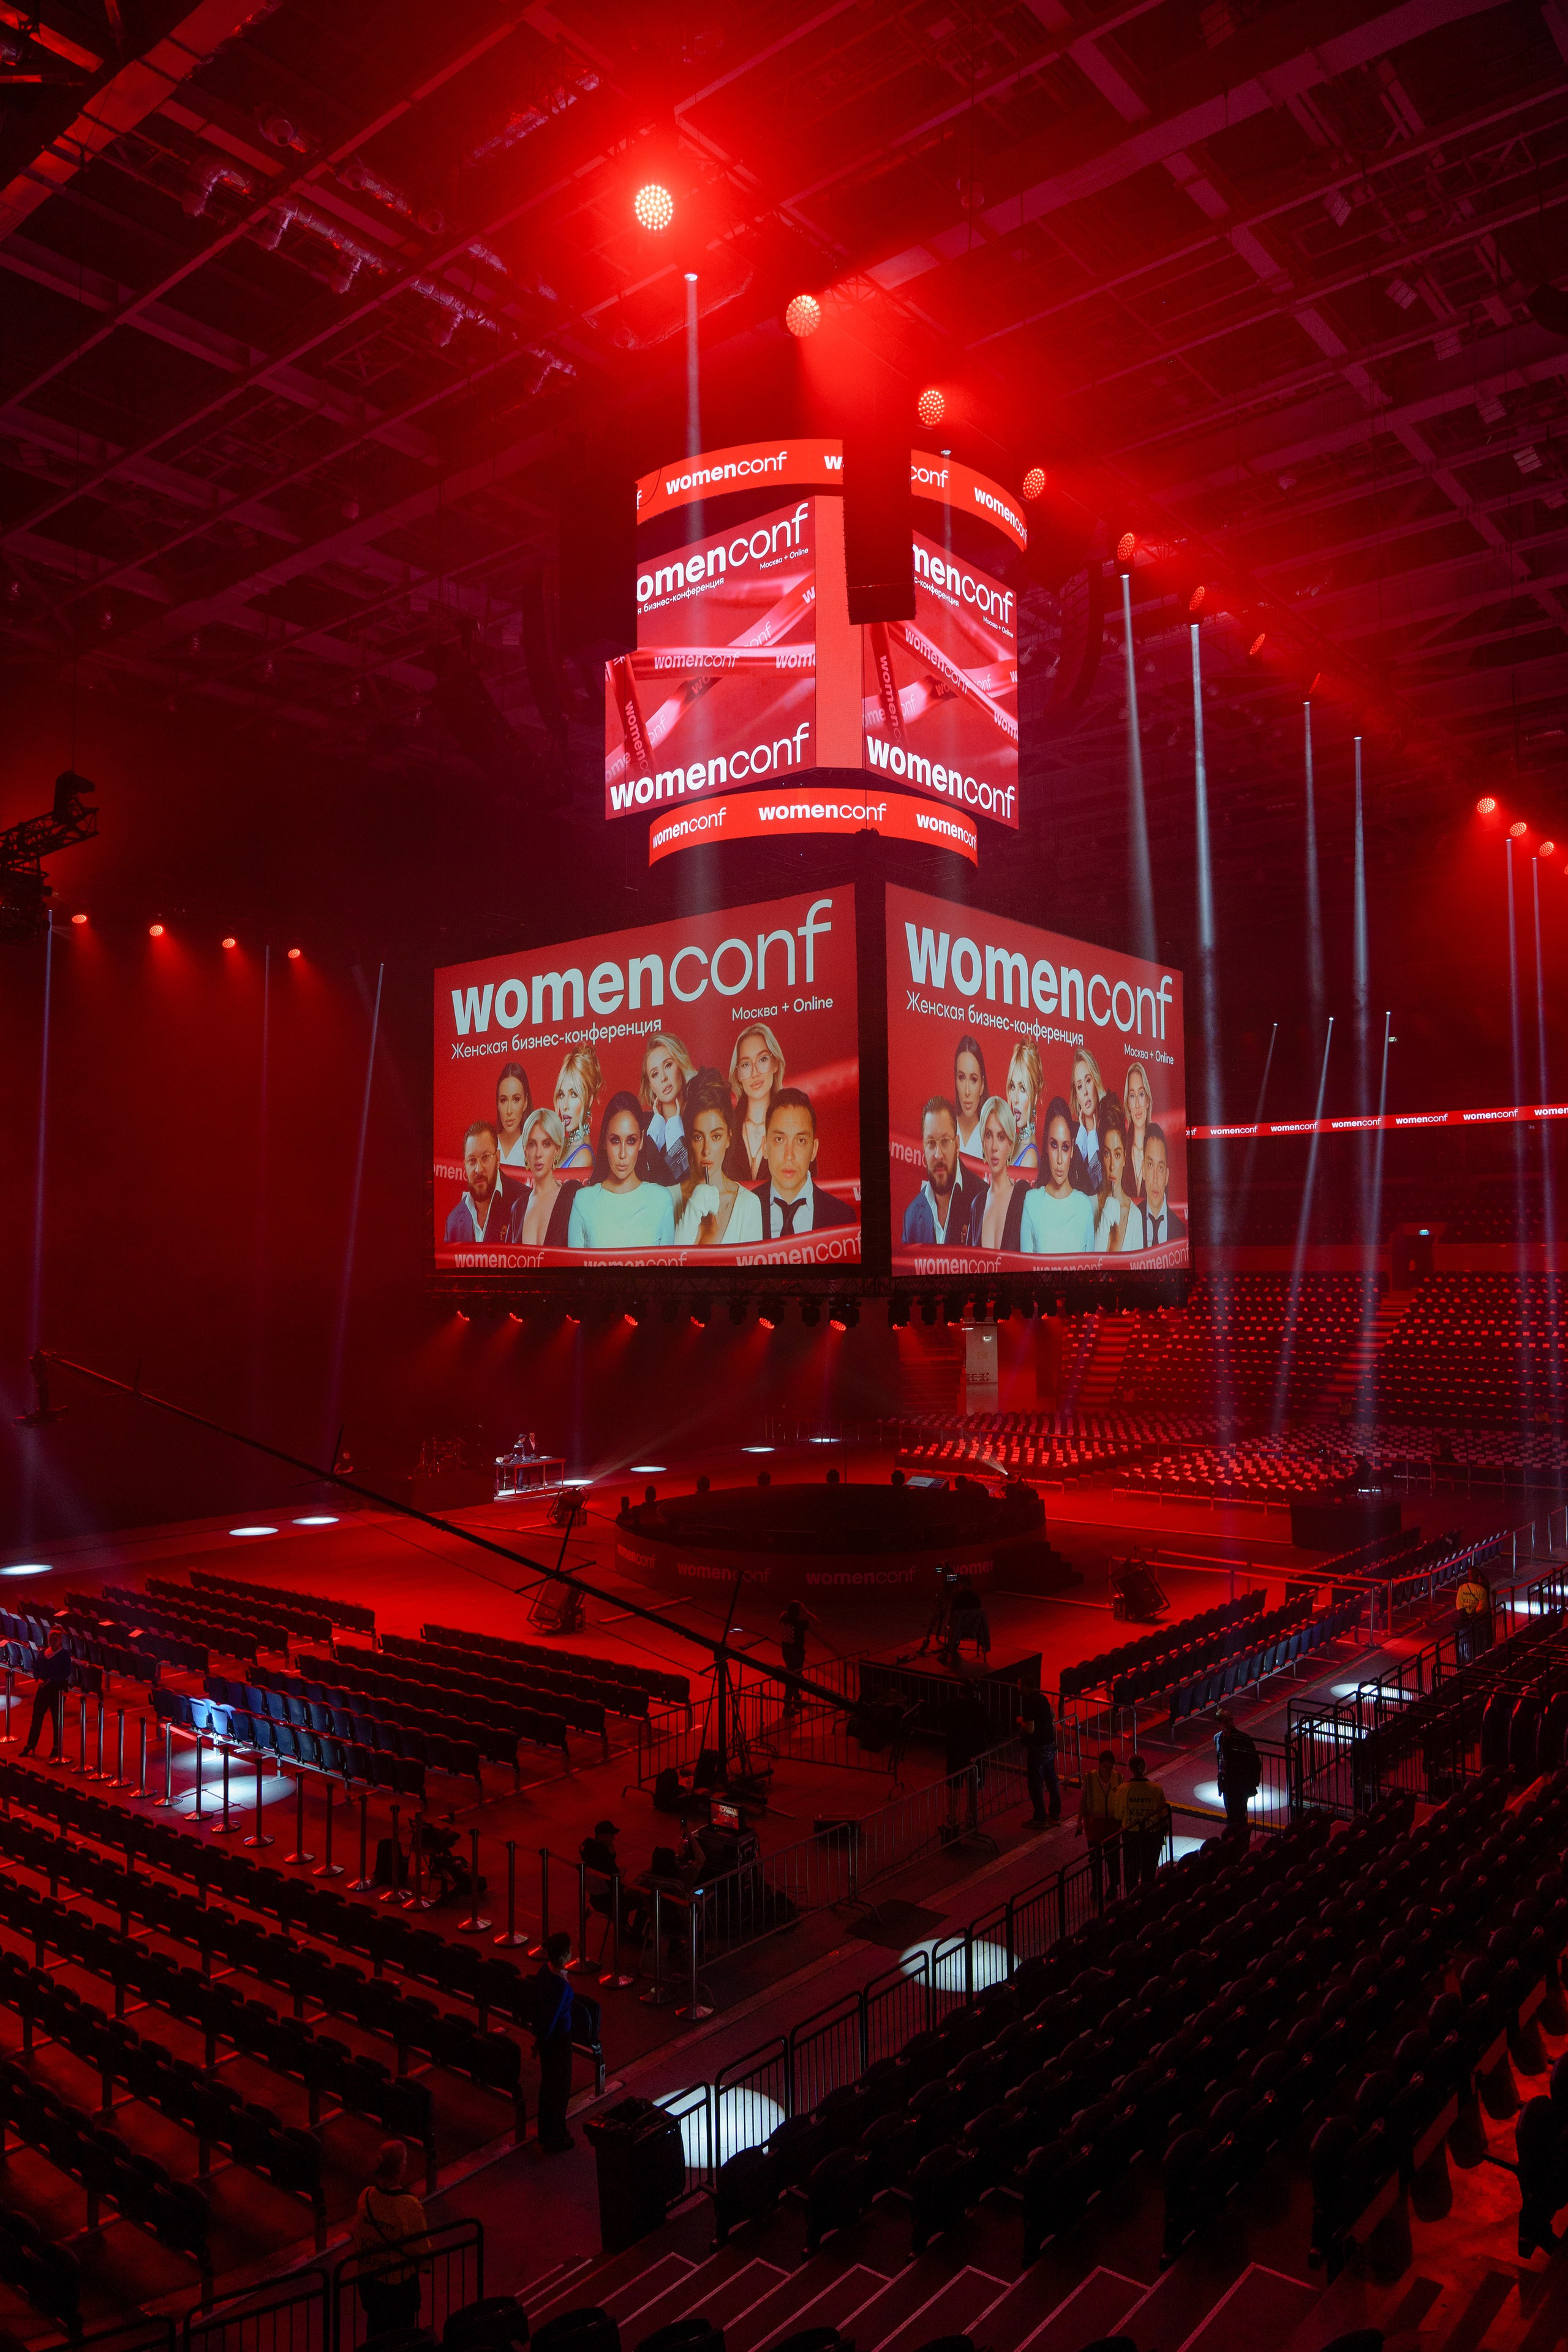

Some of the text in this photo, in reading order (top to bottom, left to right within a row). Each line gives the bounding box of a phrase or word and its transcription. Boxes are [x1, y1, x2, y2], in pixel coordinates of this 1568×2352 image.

[666, 451, 787, 495] womenconf
[637, 502, 809, 602] omenconf
[760, 557, 783, 570] Москва
[789, 548, 809, 559] Online
[643, 577, 725, 612] бизнес-конференция
[982, 615, 998, 630] Москва
[654, 652, 740, 669] womenconf
[905, 628, 970, 695] womenconf
[609, 722, 810, 811] womenconf
[867, 735, 1015, 819] womenconf
[758, 803, 887, 821] womenconf
[652, 807, 727, 850] womenconf
[916, 813, 976, 851] womenconf
[451, 898, 833, 1036] womenconf
[905, 921, 1173, 1040] womenconf
[731, 996, 834, 1021] Москва + Online
[905, 989, 1084, 1046] Женская бизнес-конференция
[451, 1018, 662, 1060] Женская бизнес-конференция
[1124, 1043, 1174, 1065] Москва + Online
[1332, 1118, 1382, 1128] womenconf
[1396, 1113, 1449, 1125] womenconf
[1463, 1109, 1519, 1120] womenconf
[1210, 1125, 1258, 1136] womenconf
[1270, 1121, 1318, 1132] womenconf
[455, 1251, 545, 1268] womenconf
[914, 1256, 1001, 1276] womenconf
[677, 1562, 771, 1584] womenconf
[805, 1566, 917, 1586] womenconf
